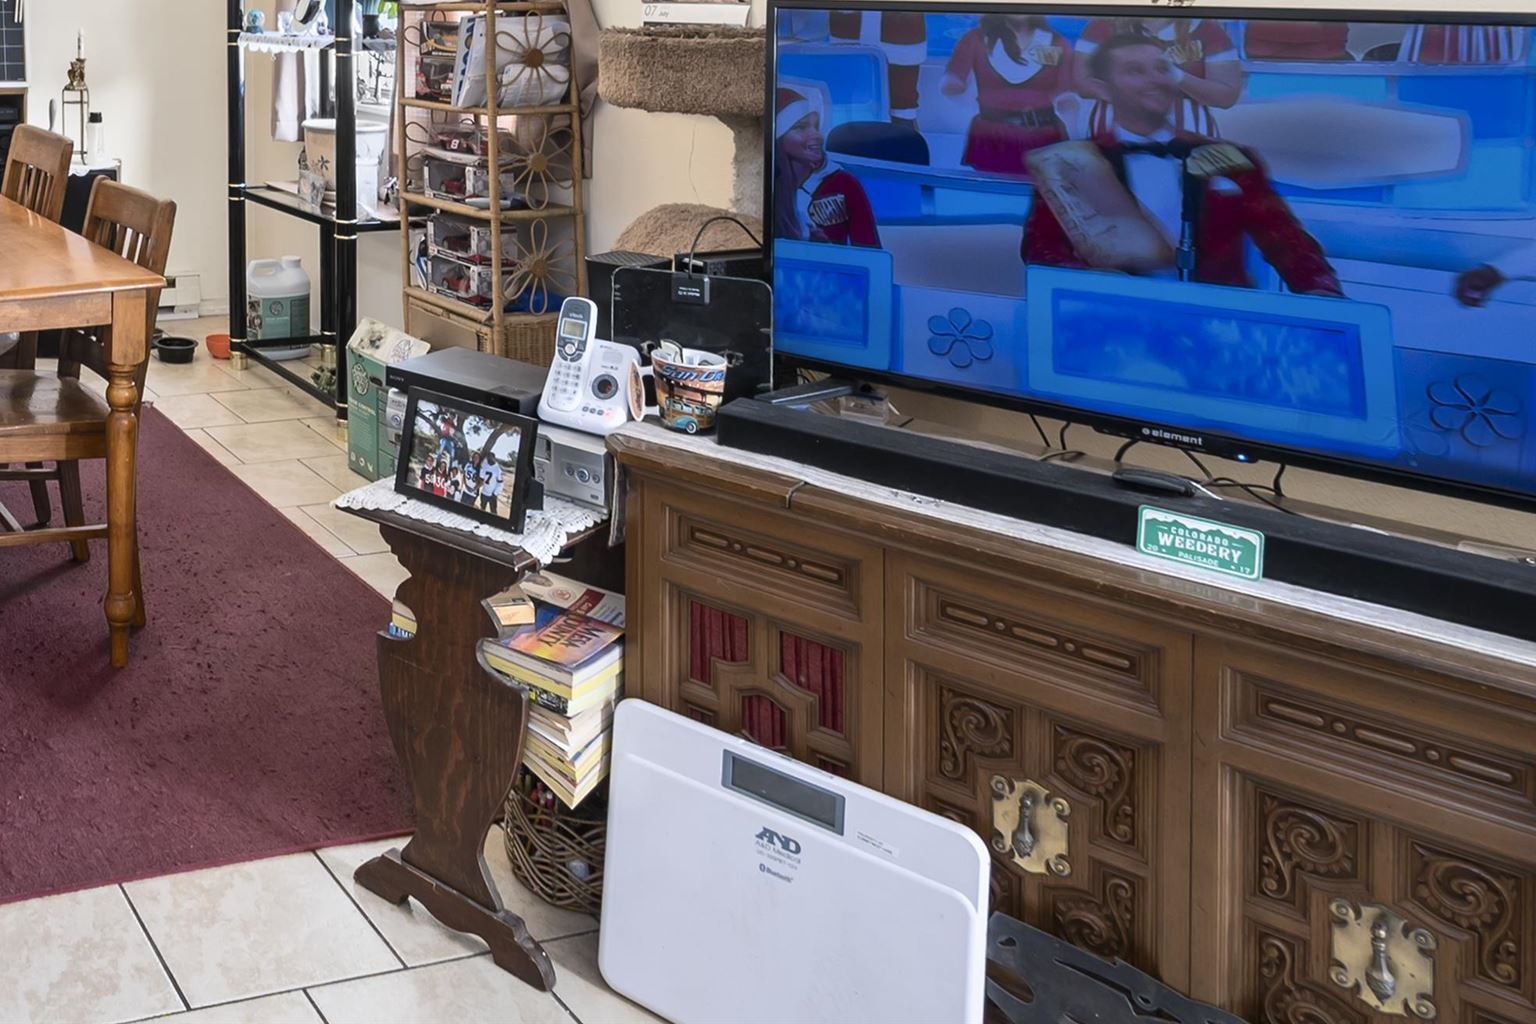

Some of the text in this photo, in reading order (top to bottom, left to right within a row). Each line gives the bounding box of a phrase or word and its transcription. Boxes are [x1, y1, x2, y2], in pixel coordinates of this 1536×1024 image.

[644, 4, 657, 17] 07
[450, 138, 460, 150] 8
[1151, 429, 1203, 446] element
[1170, 526, 1229, 546] COLORADO
[1157, 531, 1242, 564] WEEDERY
[1178, 551, 1219, 567] PALISADE
[1239, 565, 1251, 575] 17
[558, 625, 606, 648] MESA
